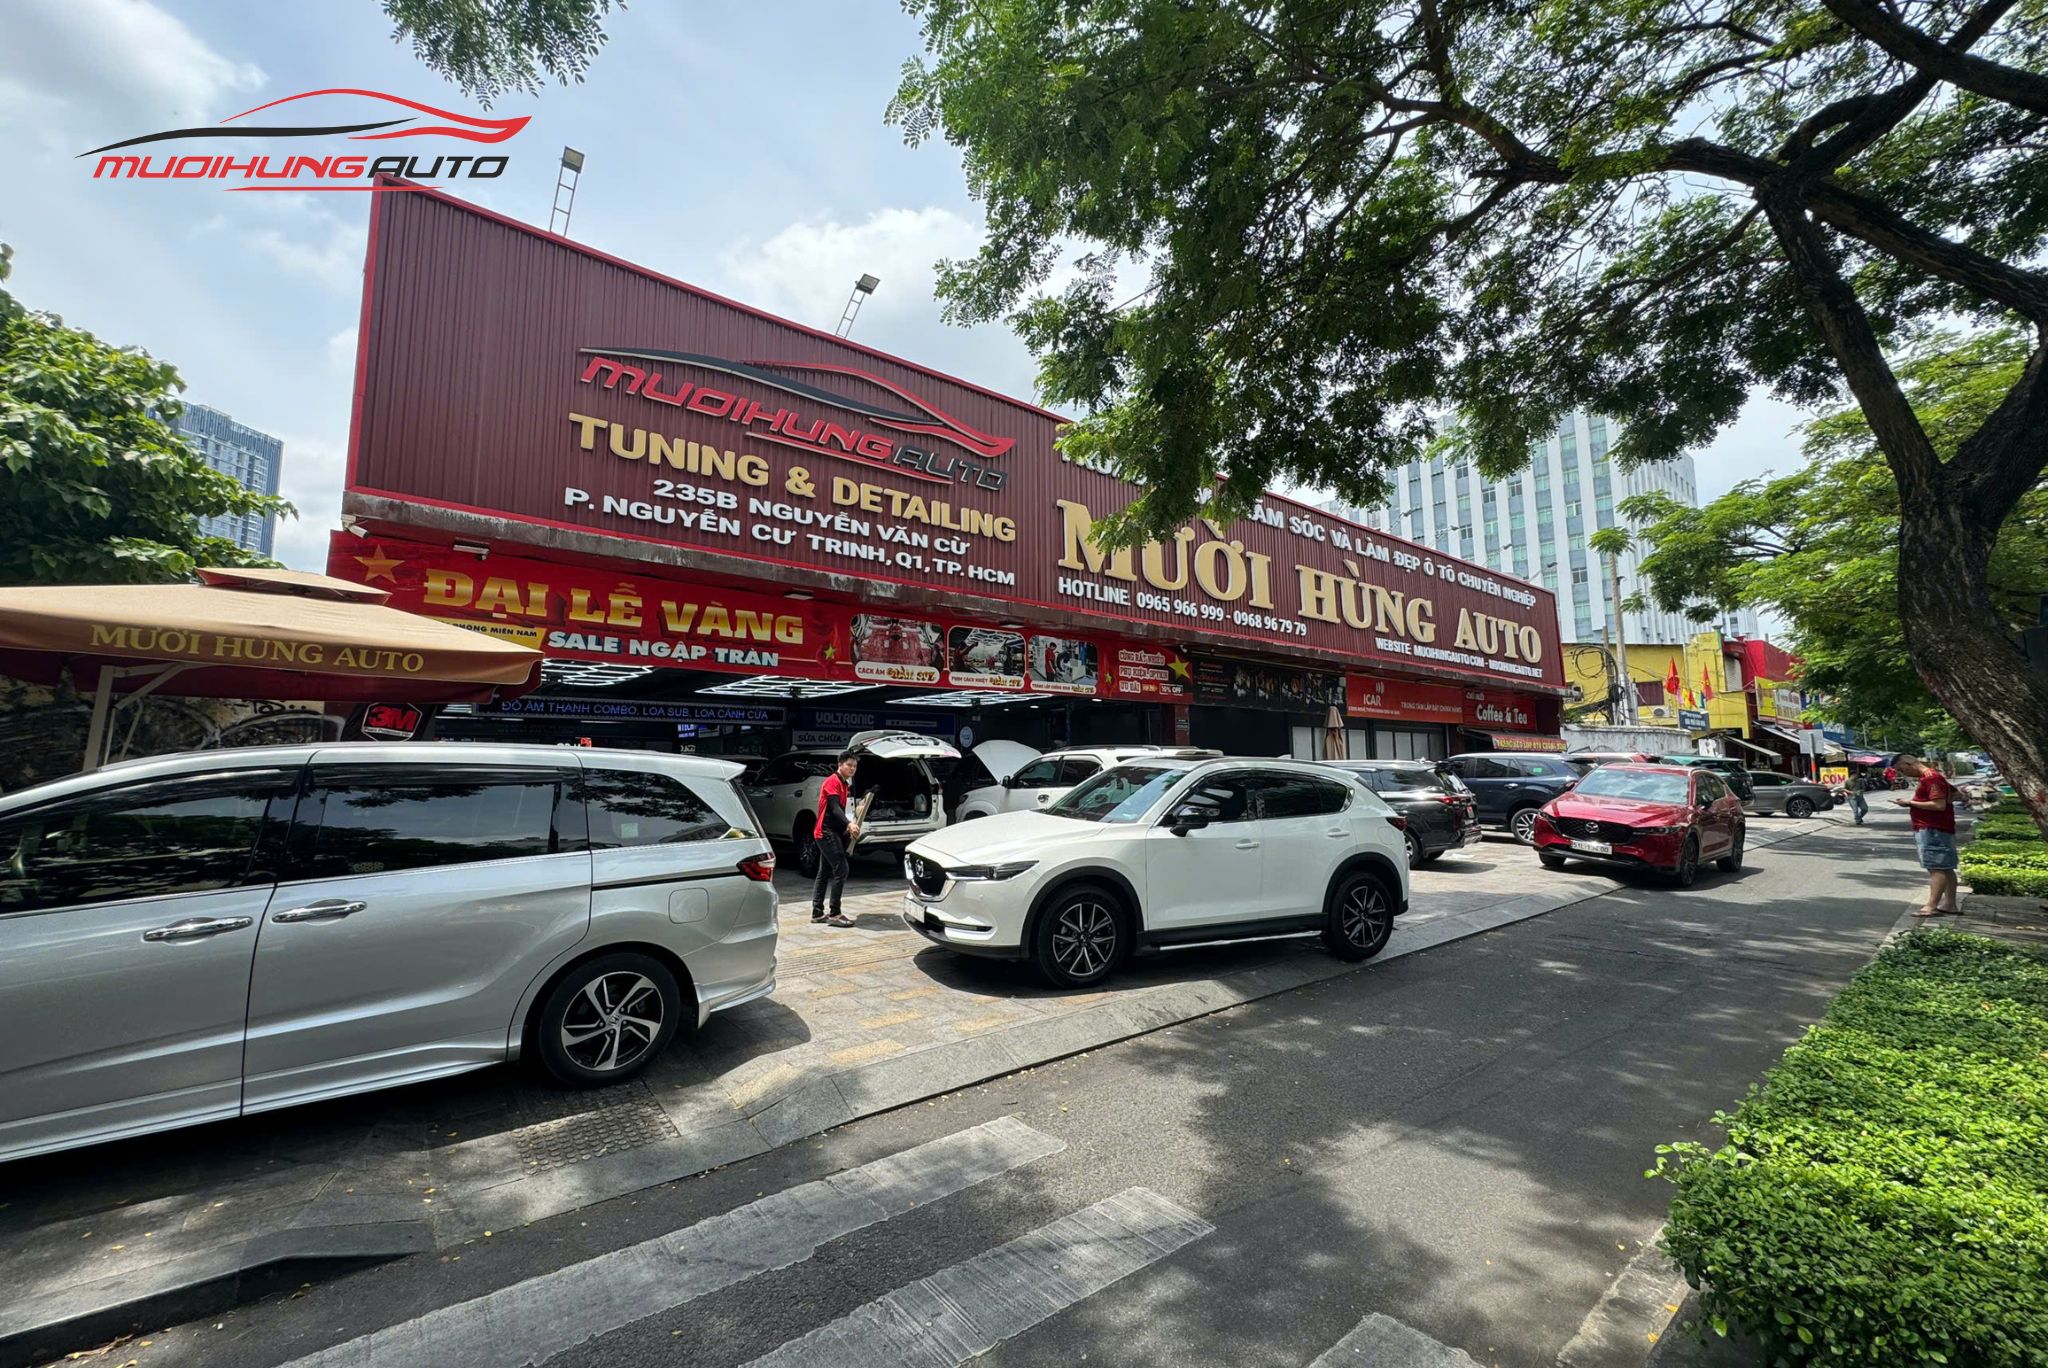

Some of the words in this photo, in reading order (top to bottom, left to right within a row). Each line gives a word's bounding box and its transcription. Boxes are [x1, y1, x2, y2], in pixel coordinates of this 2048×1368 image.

[568, 412, 770, 486] TUNING
[786, 466, 817, 499] &
[832, 476, 1017, 542] DETAILING
[564, 487, 596, 510] P.
[602, 495, 741, 537] NGUYỄN
[751, 523, 798, 546] CƯ
[653, 479, 739, 510] 235B
[749, 497, 870, 537] NGUYỄN
[876, 524, 929, 549] VĂN
[933, 535, 971, 556] CỪ
[1056, 498, 1275, 610] MƯỜI
[1295, 558, 1437, 644] HÙNG
[1454, 607, 1543, 664] AUTO
[1288, 514, 1326, 542] SÓC
[1329, 527, 1352, 551] VÀ
[1355, 537, 1390, 563] LÀM
[1393, 550, 1421, 573] ĐẸP
[1423, 557, 1435, 576] Ô
[1437, 563, 1456, 583] TÔ
[1457, 571, 1502, 597] CHUYÊN
[1503, 586, 1537, 610] NGHIỆP
[423, 567, 548, 619] ĐẠI
[568, 581, 644, 628] LỄ
[661, 600, 804, 645] VÀNG
[1136, 591, 1171, 613] 0965
[1173, 598, 1198, 618] 966
[1200, 603, 1224, 622] 999
[1233, 610, 1263, 629] 0968
[1264, 615, 1278, 632] 96
[1278, 618, 1293, 634] 79
[1294, 621, 1307, 636] 79
[516, 629, 537, 638] NAM
[547, 630, 619, 654] SALE
[628, 639, 707, 663] NGẬP
[714, 645, 779, 668] TRÀN
[333, 647, 425, 673] AUTO
[367, 705, 418, 732] 3M
[547, 701, 590, 714] THANH
[642, 706, 666, 717] LOA
[694, 707, 717, 719] LOA
[815, 710, 876, 725] VOLTRONIC
[1363, 693, 1382, 707] ICAR
[1476, 703, 1504, 723] Coffee
[1513, 707, 1528, 725] Tea
